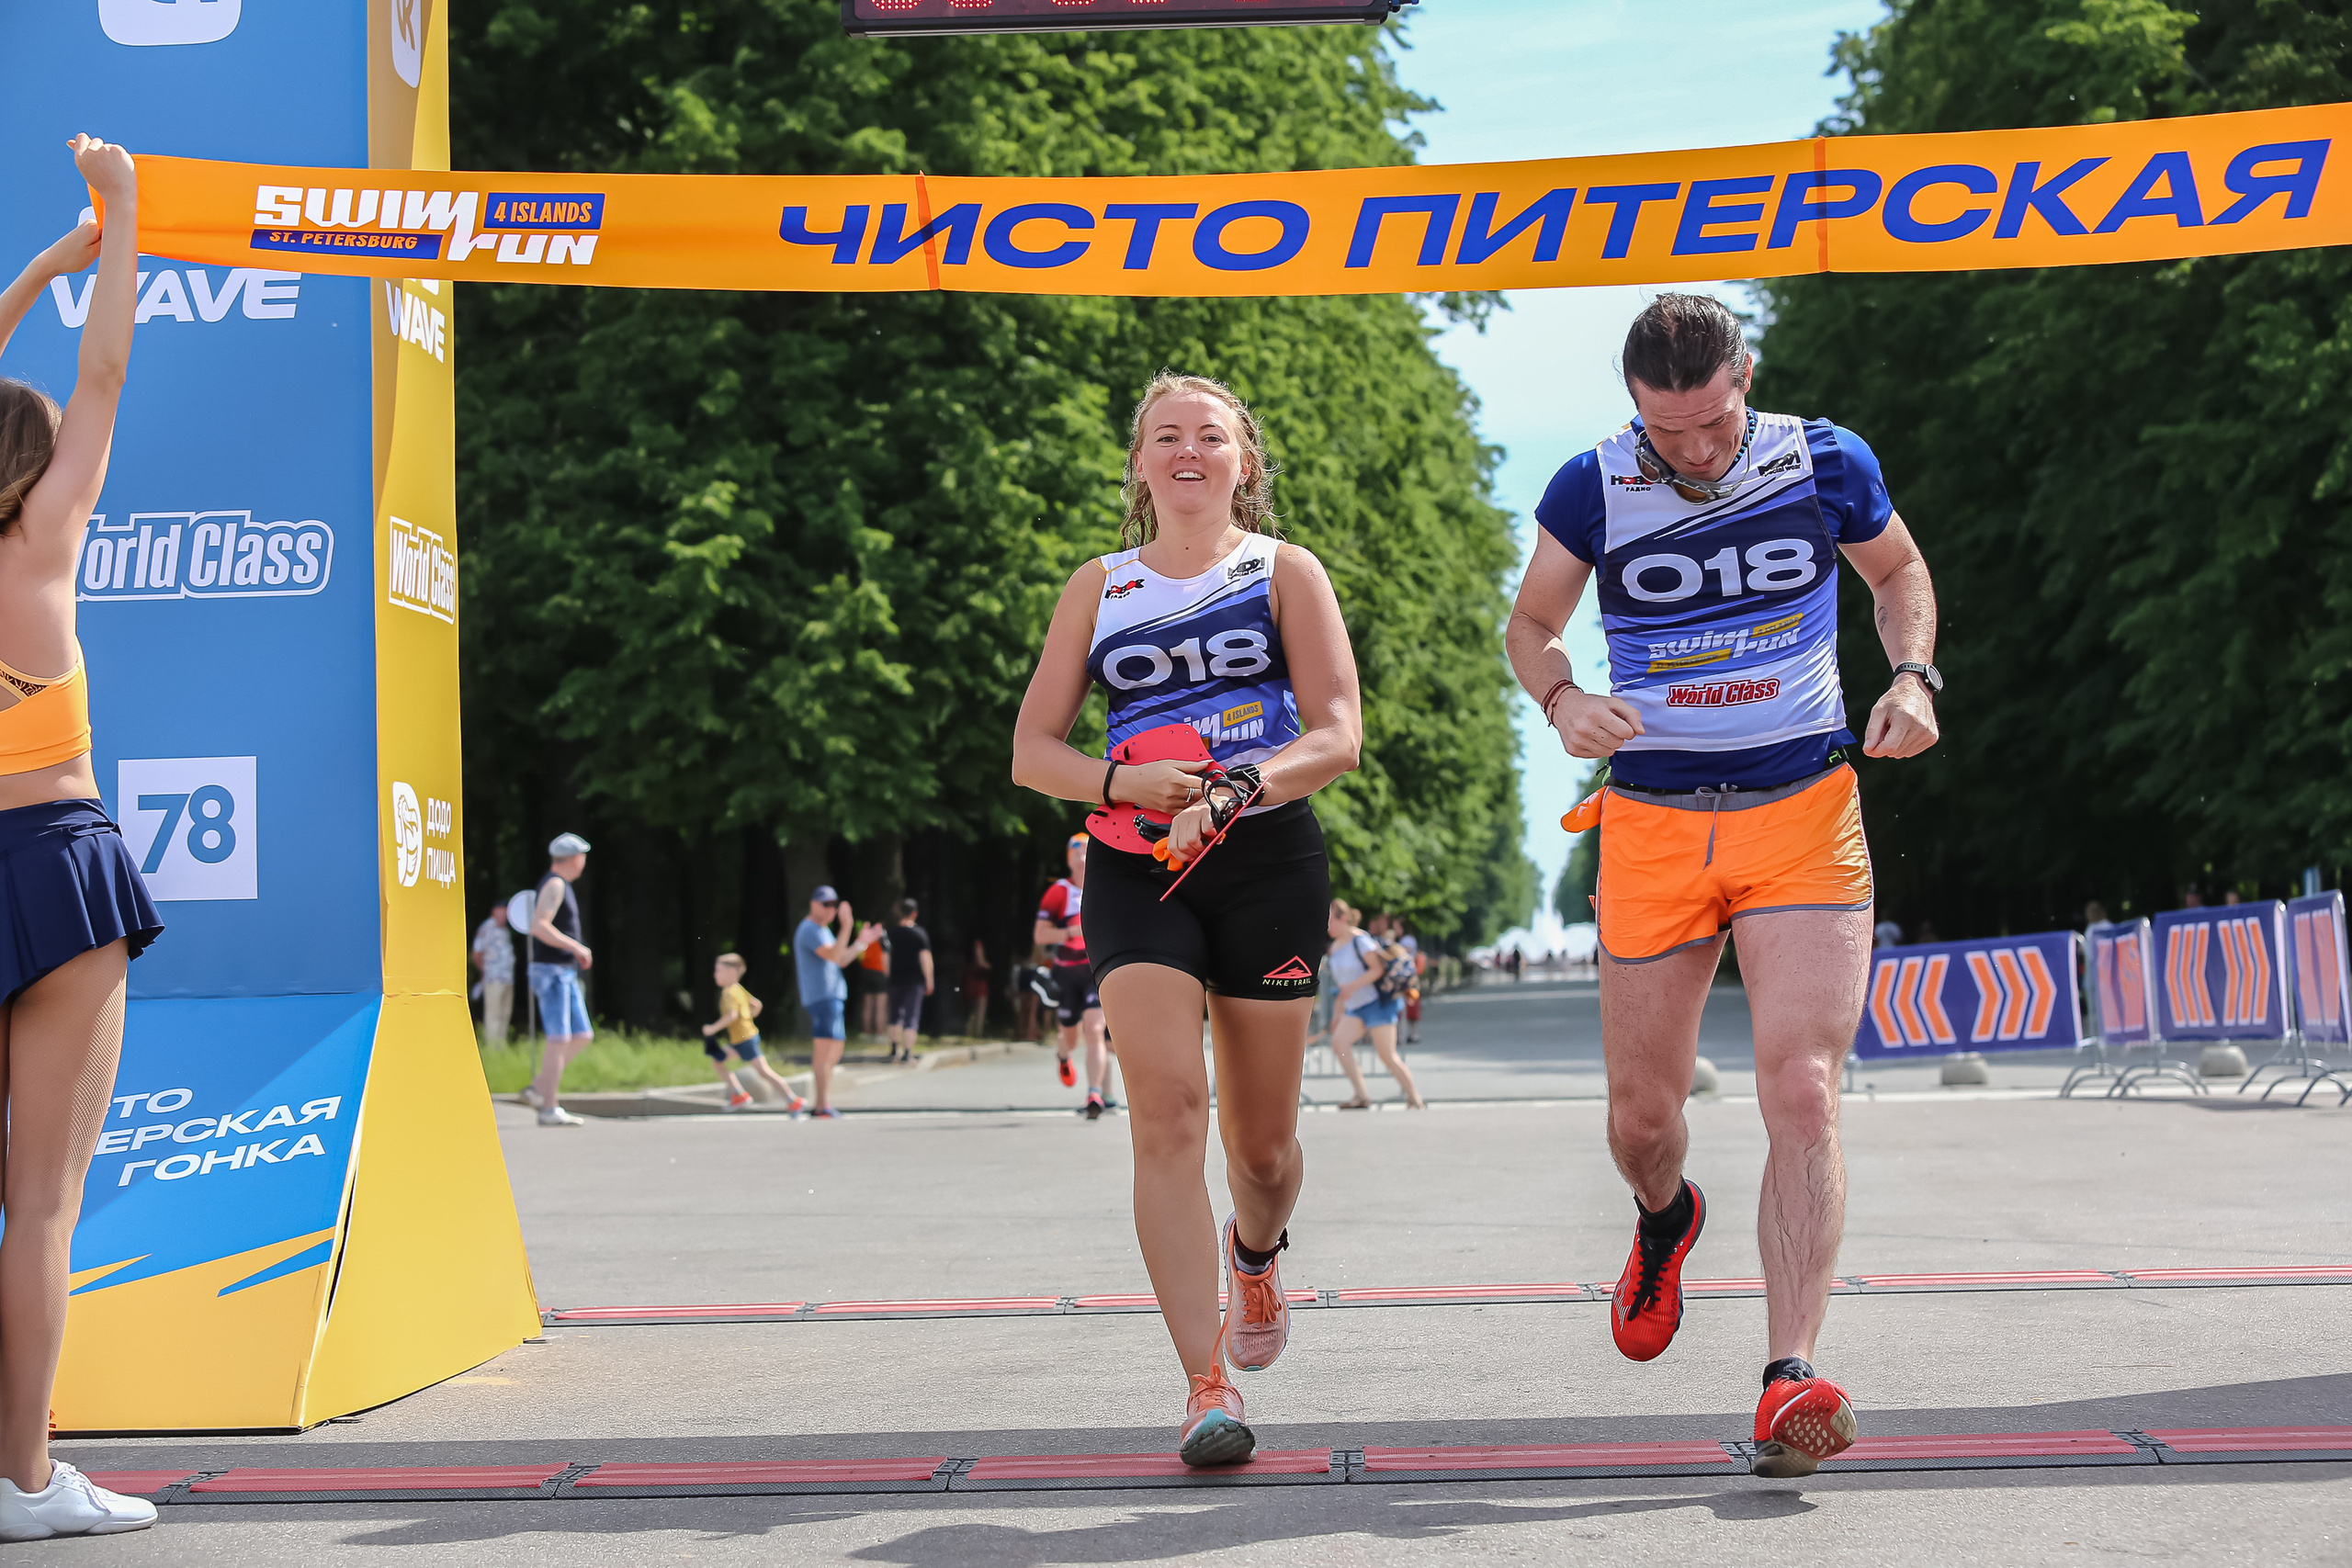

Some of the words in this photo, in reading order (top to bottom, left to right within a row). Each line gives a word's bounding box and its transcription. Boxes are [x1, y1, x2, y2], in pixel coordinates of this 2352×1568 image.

[493, 202, 506, 221] 4
[511, 201, 593, 223] ISLANDS
[778, 199, 1310, 271] ЧИСТО
[1343, 139, 2332, 269] ПИТЕРСКАЯ
[269, 231, 296, 243] ST.
[300, 233, 418, 250] PETERSBURG
[386, 280, 446, 364] WAVE
[75, 524, 183, 590] orld
[188, 522, 321, 587] Class
[391, 529, 431, 603] World
[431, 545, 454, 614] Class
[1622, 538, 1817, 603] 018
[1102, 629, 1272, 690] 018
[1227, 713, 1232, 722] 4
[1233, 705, 1259, 720] ISLANDS
[1669, 686, 1724, 705] World
[1725, 682, 1777, 704] Class
[138, 784, 236, 874] 78
[426, 797, 452, 840] ДОДО
[426, 847, 456, 889] ПИЦЦА
[1262, 978, 1289, 987] NIKE
[94, 1095, 343, 1156] ЕРСКАЯ
[107, 1088, 194, 1119] ТО
[118, 1134, 326, 1188] ГОНКА
